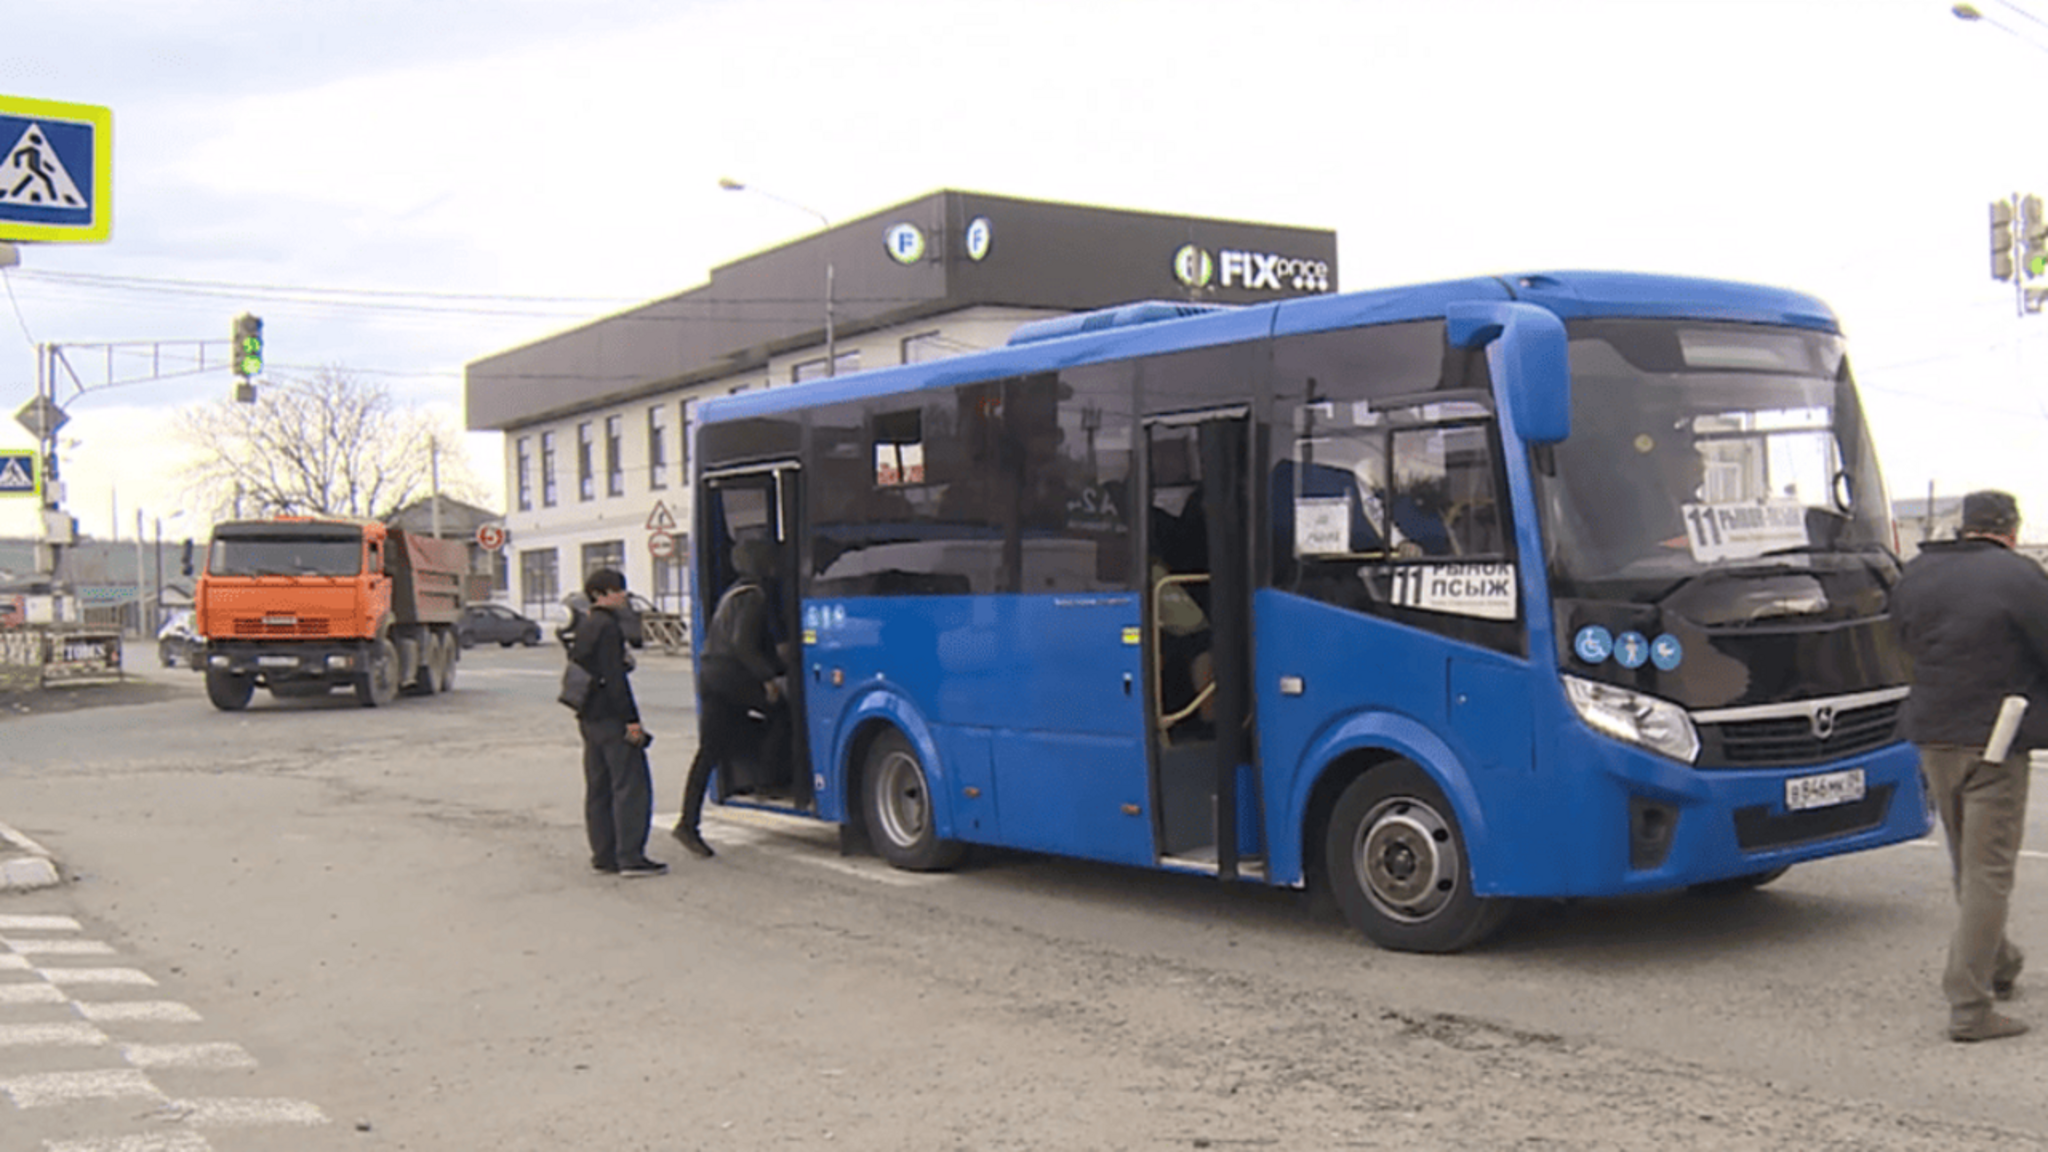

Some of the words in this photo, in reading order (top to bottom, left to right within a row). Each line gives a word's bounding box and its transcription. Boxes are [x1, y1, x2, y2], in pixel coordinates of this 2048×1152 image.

[1220, 250, 1281, 289] FIX
[1688, 507, 1722, 546] 11
[1397, 565, 1423, 607] 11
[1431, 579, 1511, 597] ПСЫЖ
